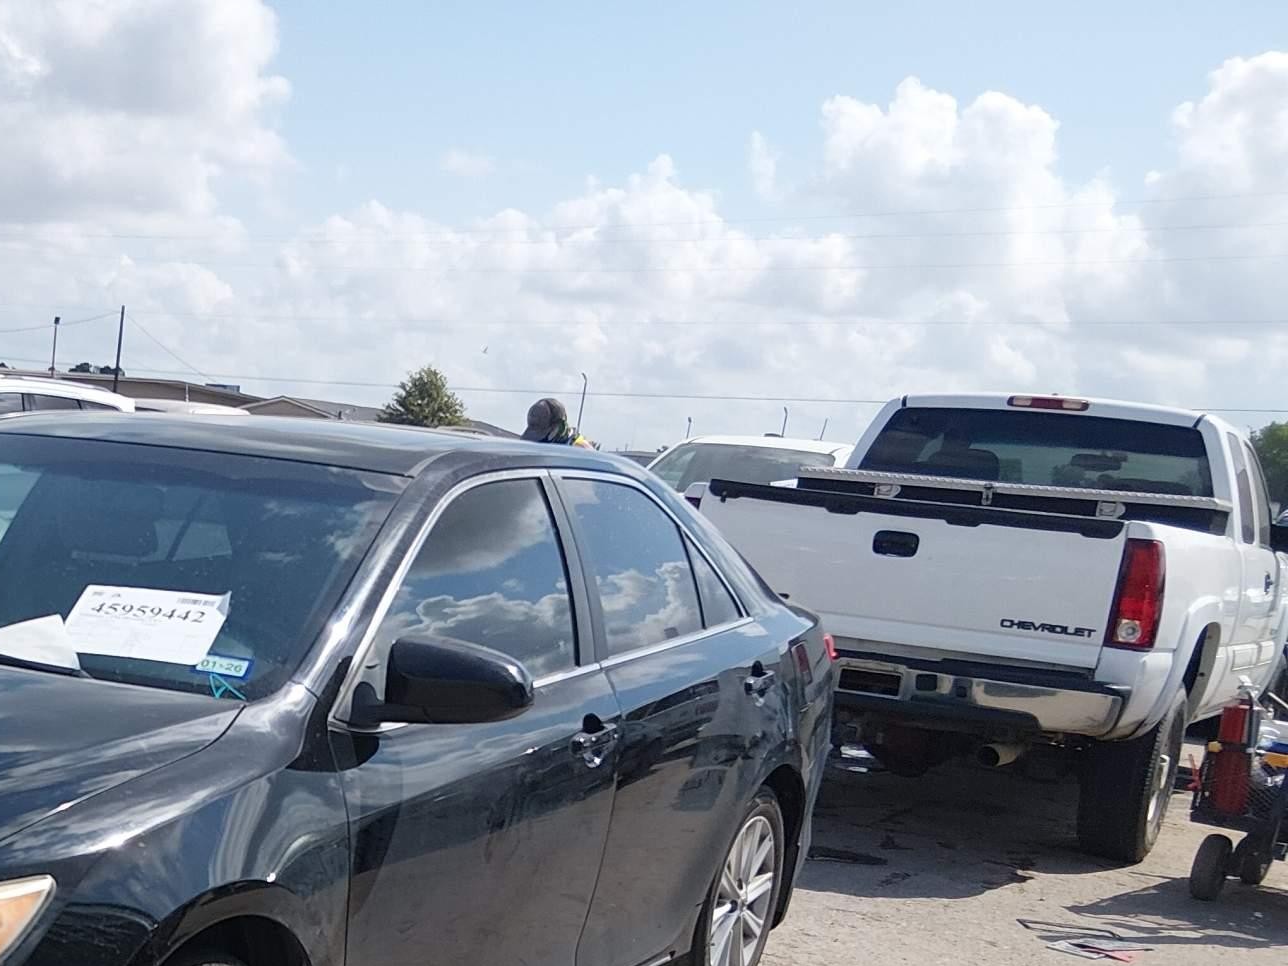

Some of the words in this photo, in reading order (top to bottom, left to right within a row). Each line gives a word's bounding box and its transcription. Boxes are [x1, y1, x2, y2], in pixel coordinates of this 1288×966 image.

[91, 602, 206, 624] 45959442
[999, 618, 1097, 638] CHEVROLET
[201, 659, 244, 673] 01-26
